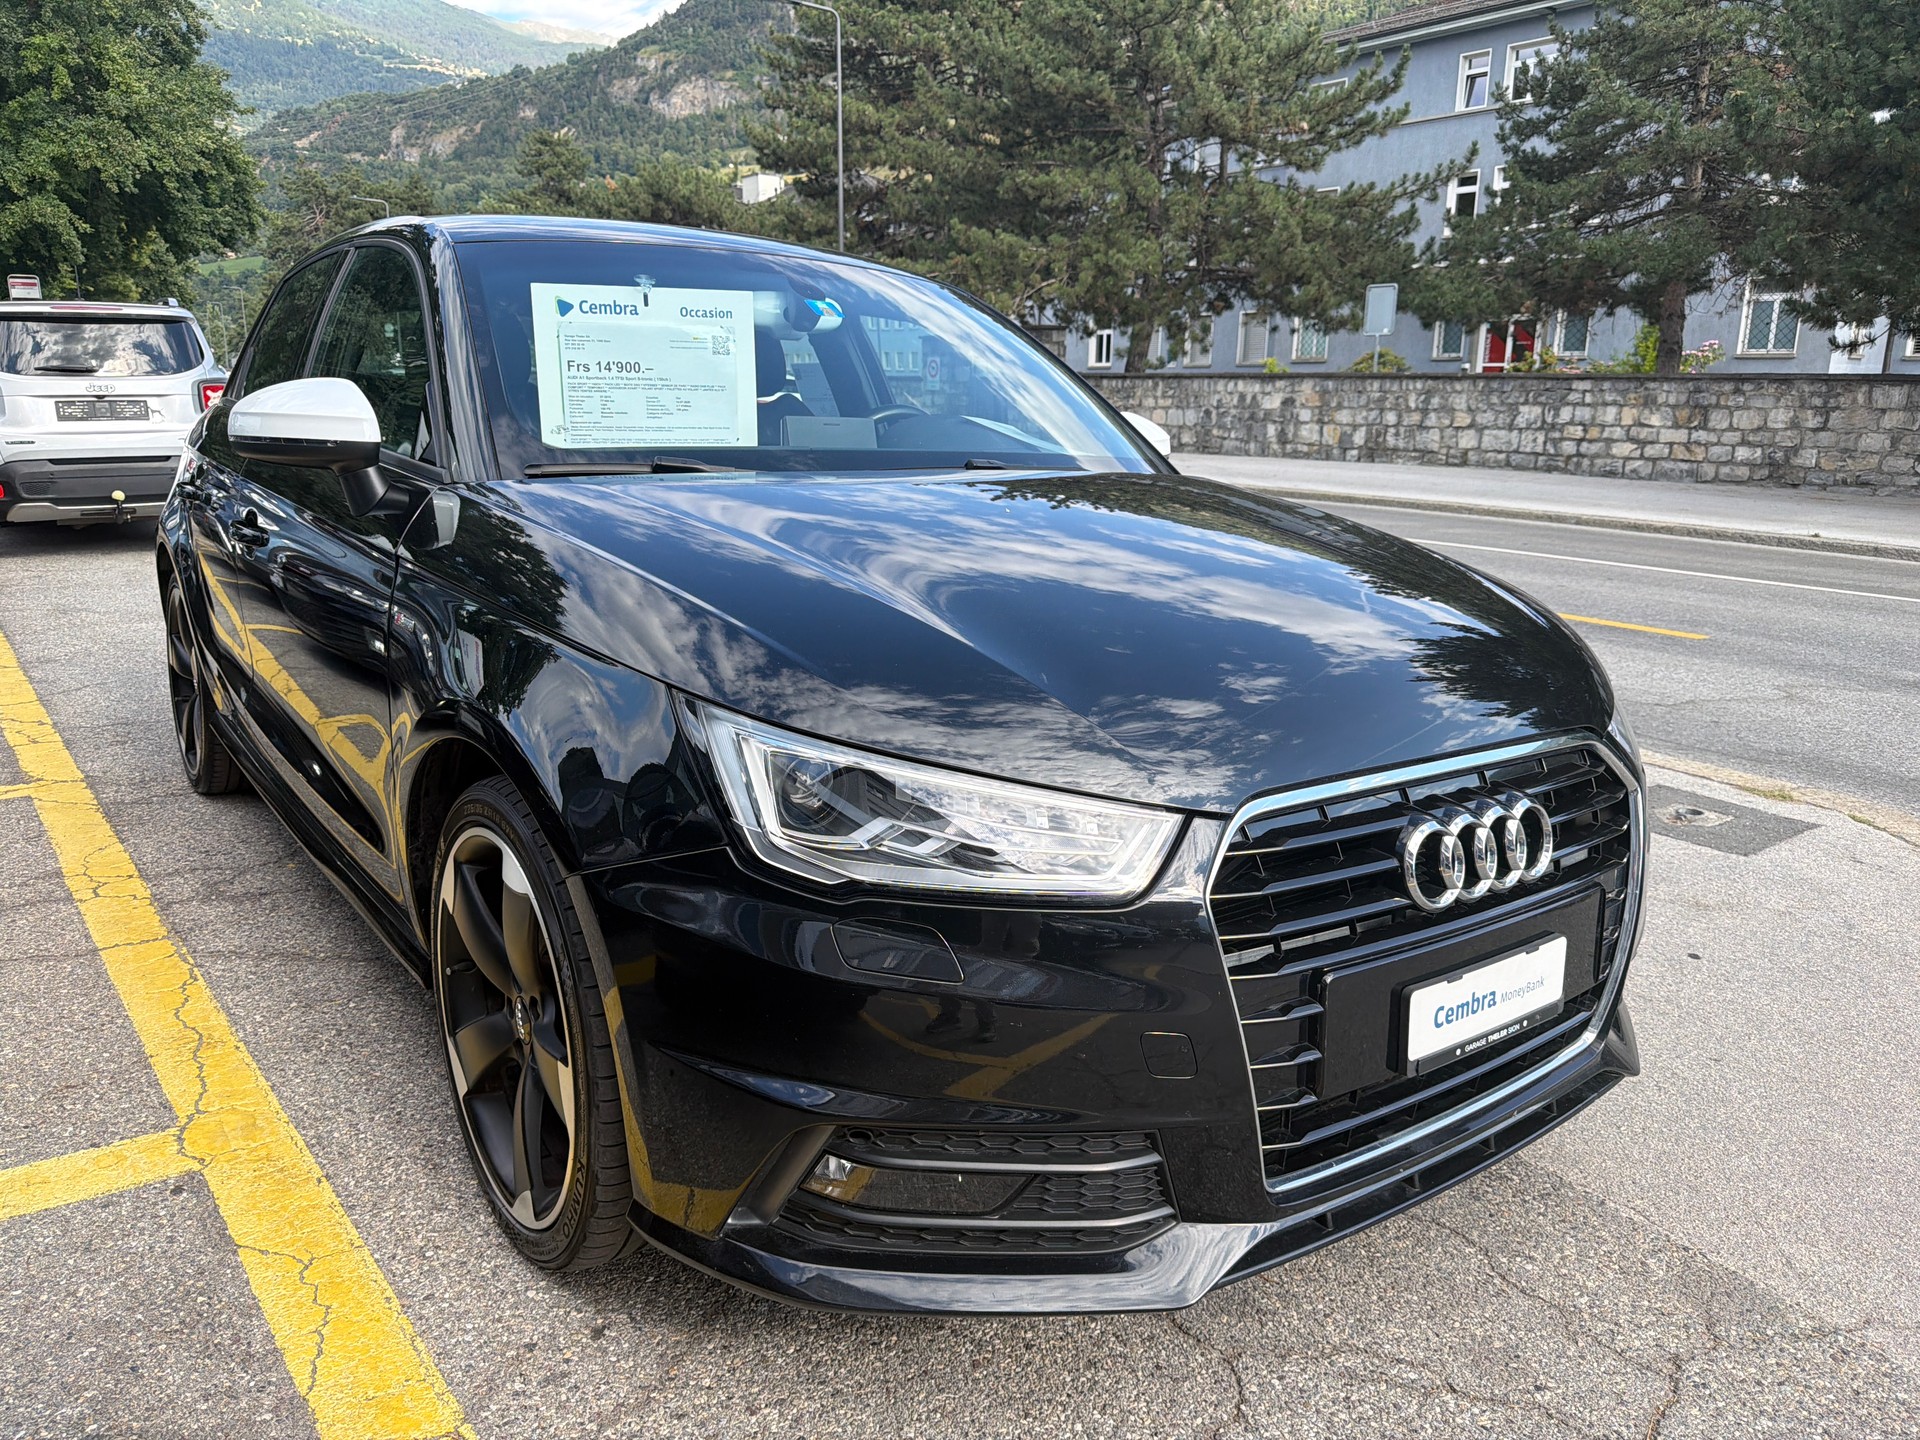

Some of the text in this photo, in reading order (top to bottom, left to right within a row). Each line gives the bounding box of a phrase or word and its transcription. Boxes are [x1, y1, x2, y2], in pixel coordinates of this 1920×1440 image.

[578, 299, 640, 316] Cembra
[679, 306, 733, 319] Occasion
[566, 359, 591, 373] Frs
[85, 382, 116, 393] Jeep
[1433, 976, 1545, 1029] Cembra MoneyBank
[1464, 1037, 1487, 1053] GARAGE
[1508, 1023, 1521, 1035] SION
[562, 1157, 586, 1240] KUMHO
